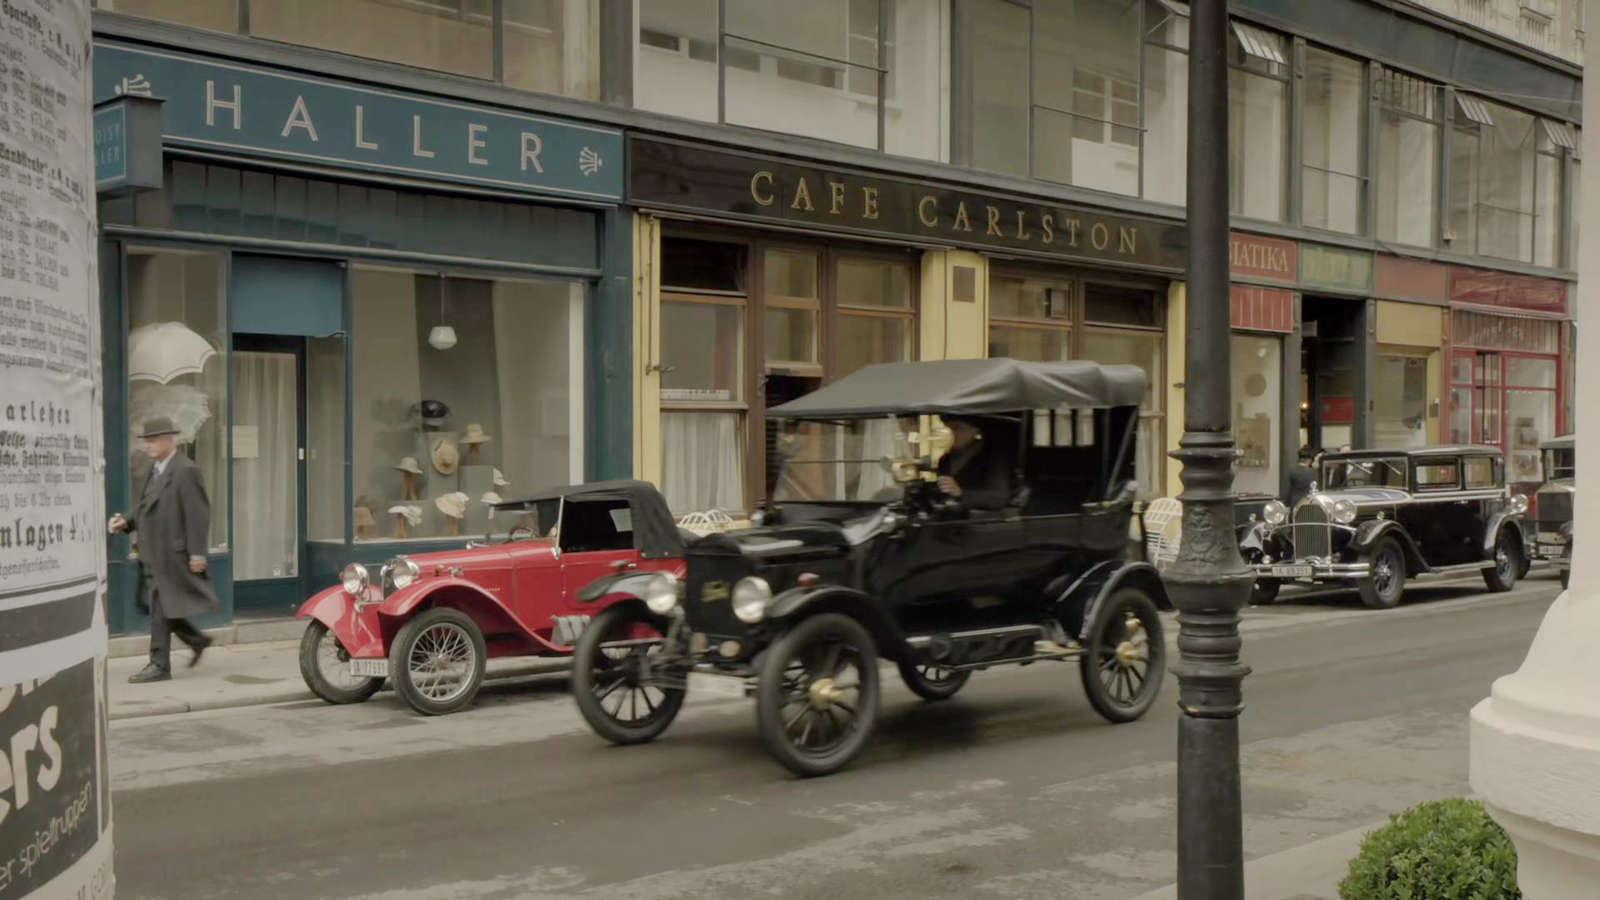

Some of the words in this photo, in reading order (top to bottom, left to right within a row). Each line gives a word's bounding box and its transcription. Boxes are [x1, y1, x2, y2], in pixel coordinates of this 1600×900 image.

[206, 81, 544, 173] HALLER
[750, 171, 879, 219] CAFE
[919, 196, 1138, 255] CARLSTON
[1229, 241, 1289, 272] IATIKA
